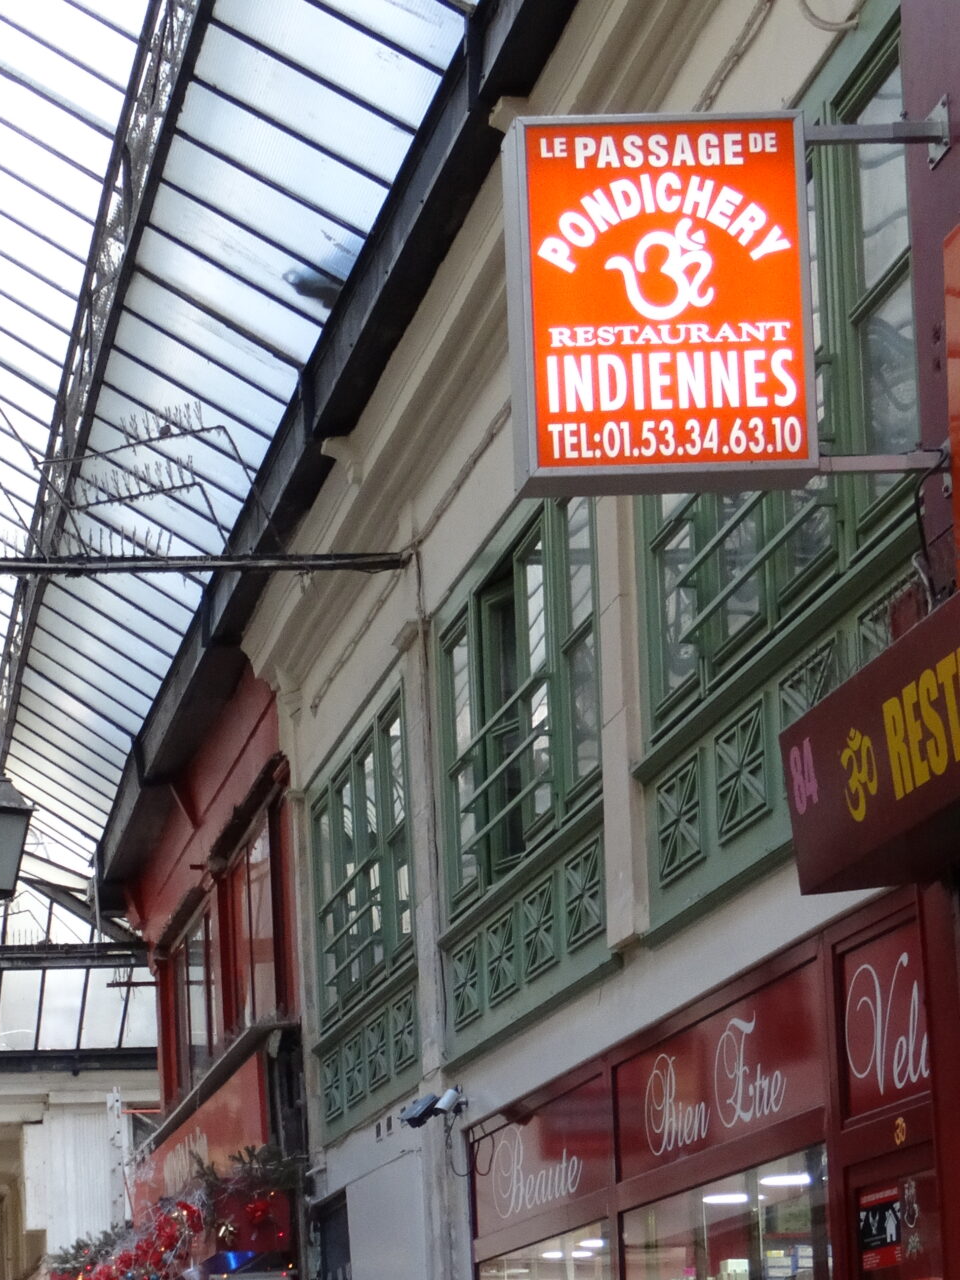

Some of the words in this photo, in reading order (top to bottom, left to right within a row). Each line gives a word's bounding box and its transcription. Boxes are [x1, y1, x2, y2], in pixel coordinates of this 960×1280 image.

[540, 137, 568, 158] LE
[574, 132, 745, 170] PASSAGE
[748, 132, 778, 154] DE
[537, 171, 792, 274] PONDICHERY
[548, 321, 791, 347] RESTAURANT
[545, 348, 798, 414] INDIENNES
[882, 648, 960, 801] REST
[789, 736, 819, 816] 84
[644, 1053, 712, 1156] Bien
[492, 1126, 584, 1219] Beaute
